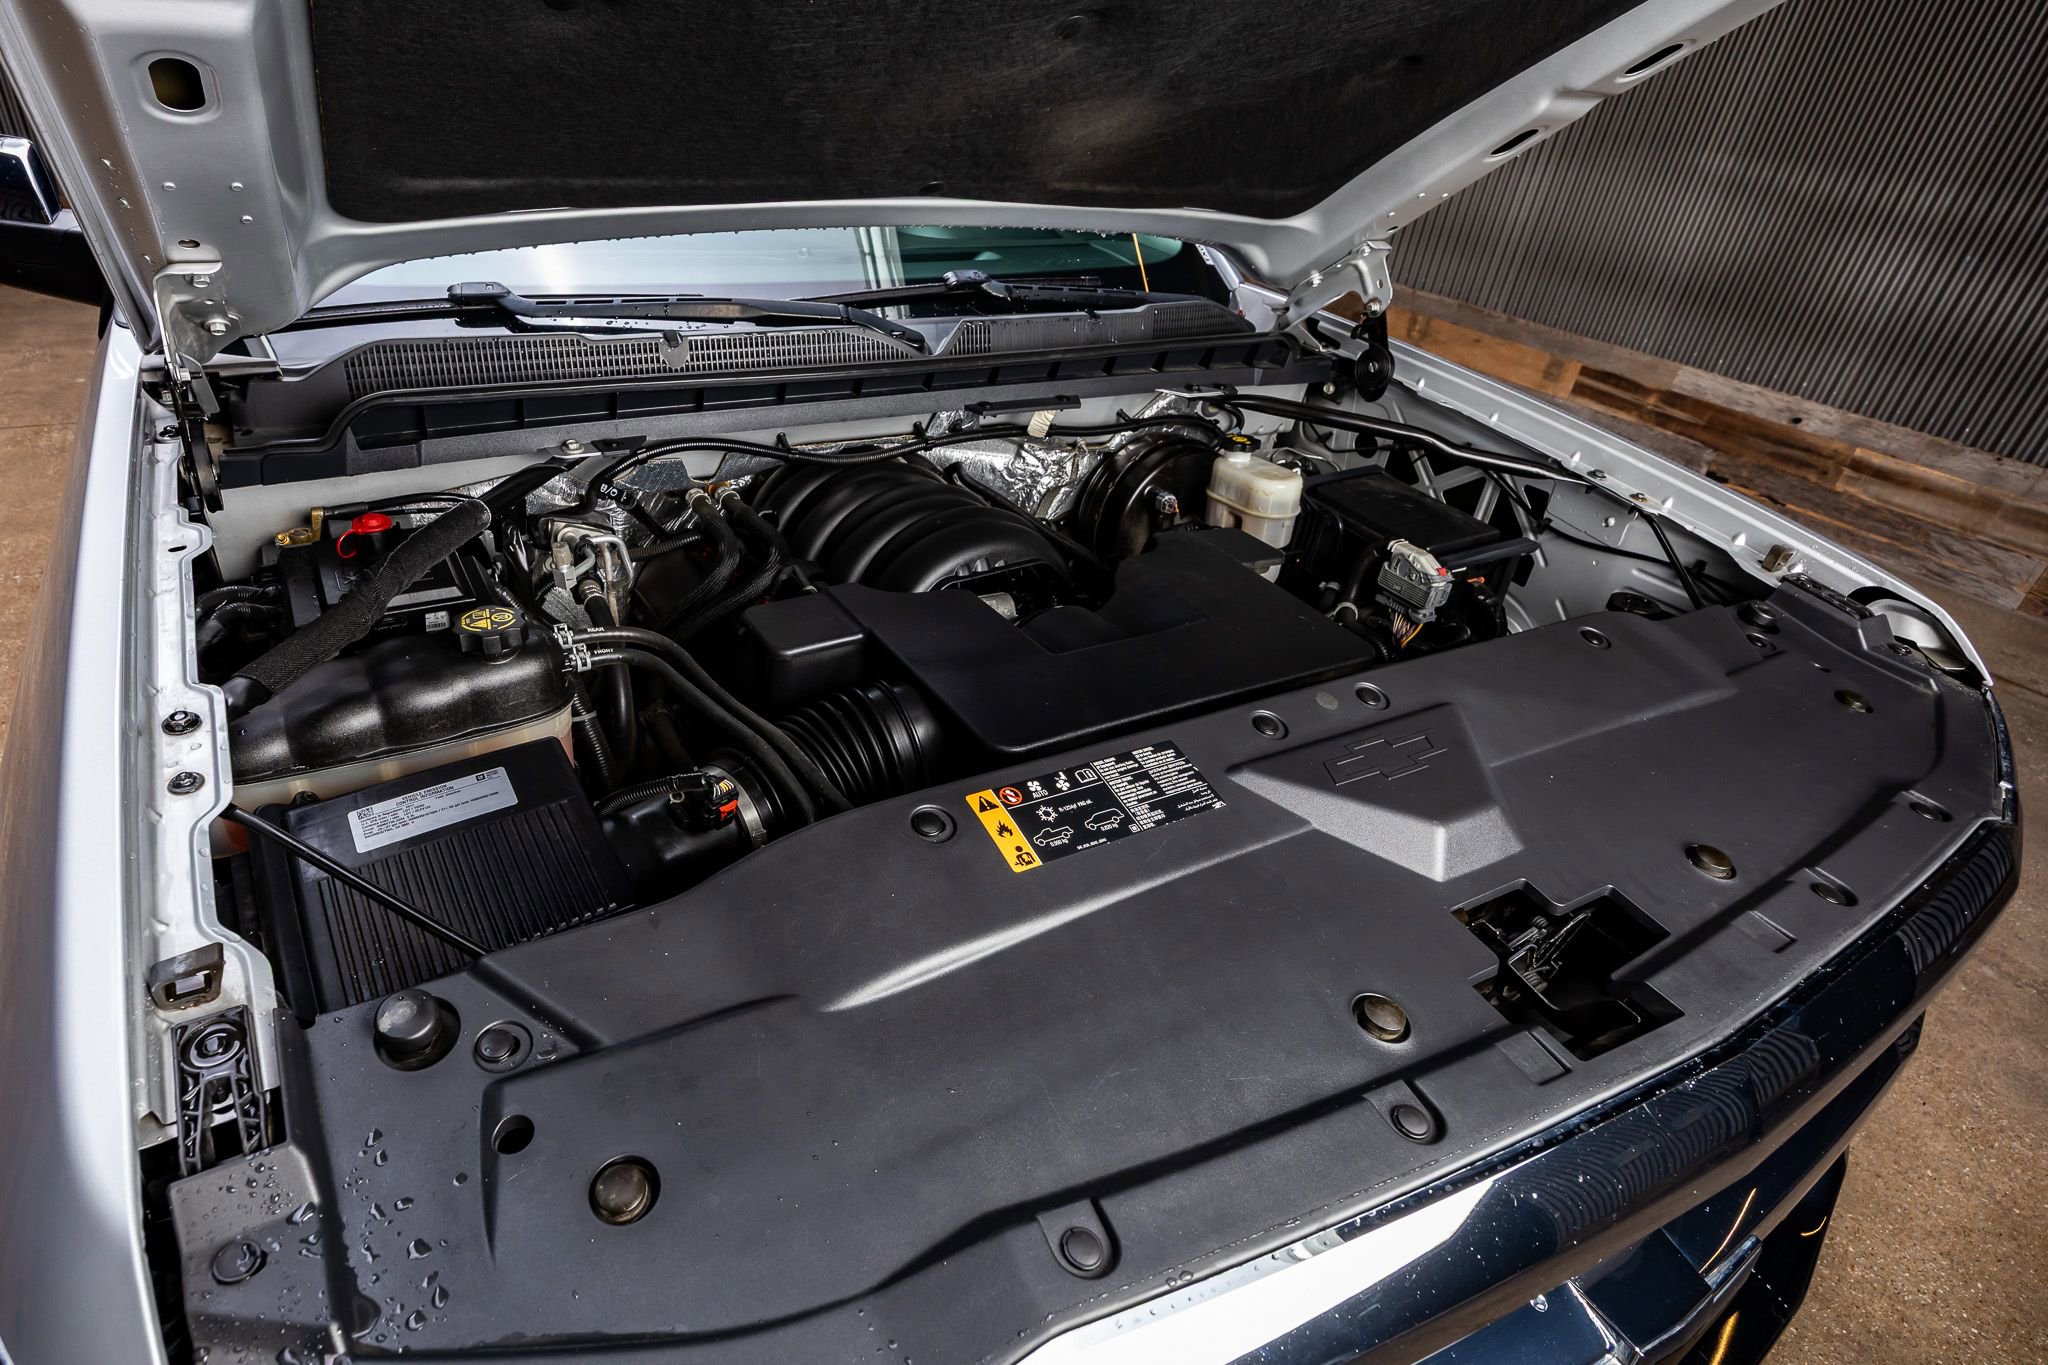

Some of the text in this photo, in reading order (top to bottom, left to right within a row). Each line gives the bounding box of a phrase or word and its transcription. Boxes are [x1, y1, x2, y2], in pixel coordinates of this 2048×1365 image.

[396, 797, 418, 806] CONTROL
[420, 786, 454, 799] INFORMATION
[401, 791, 421, 801] VEHICLE
[423, 784, 447, 795] EMISSION
[1032, 789, 1049, 799] AUTO
